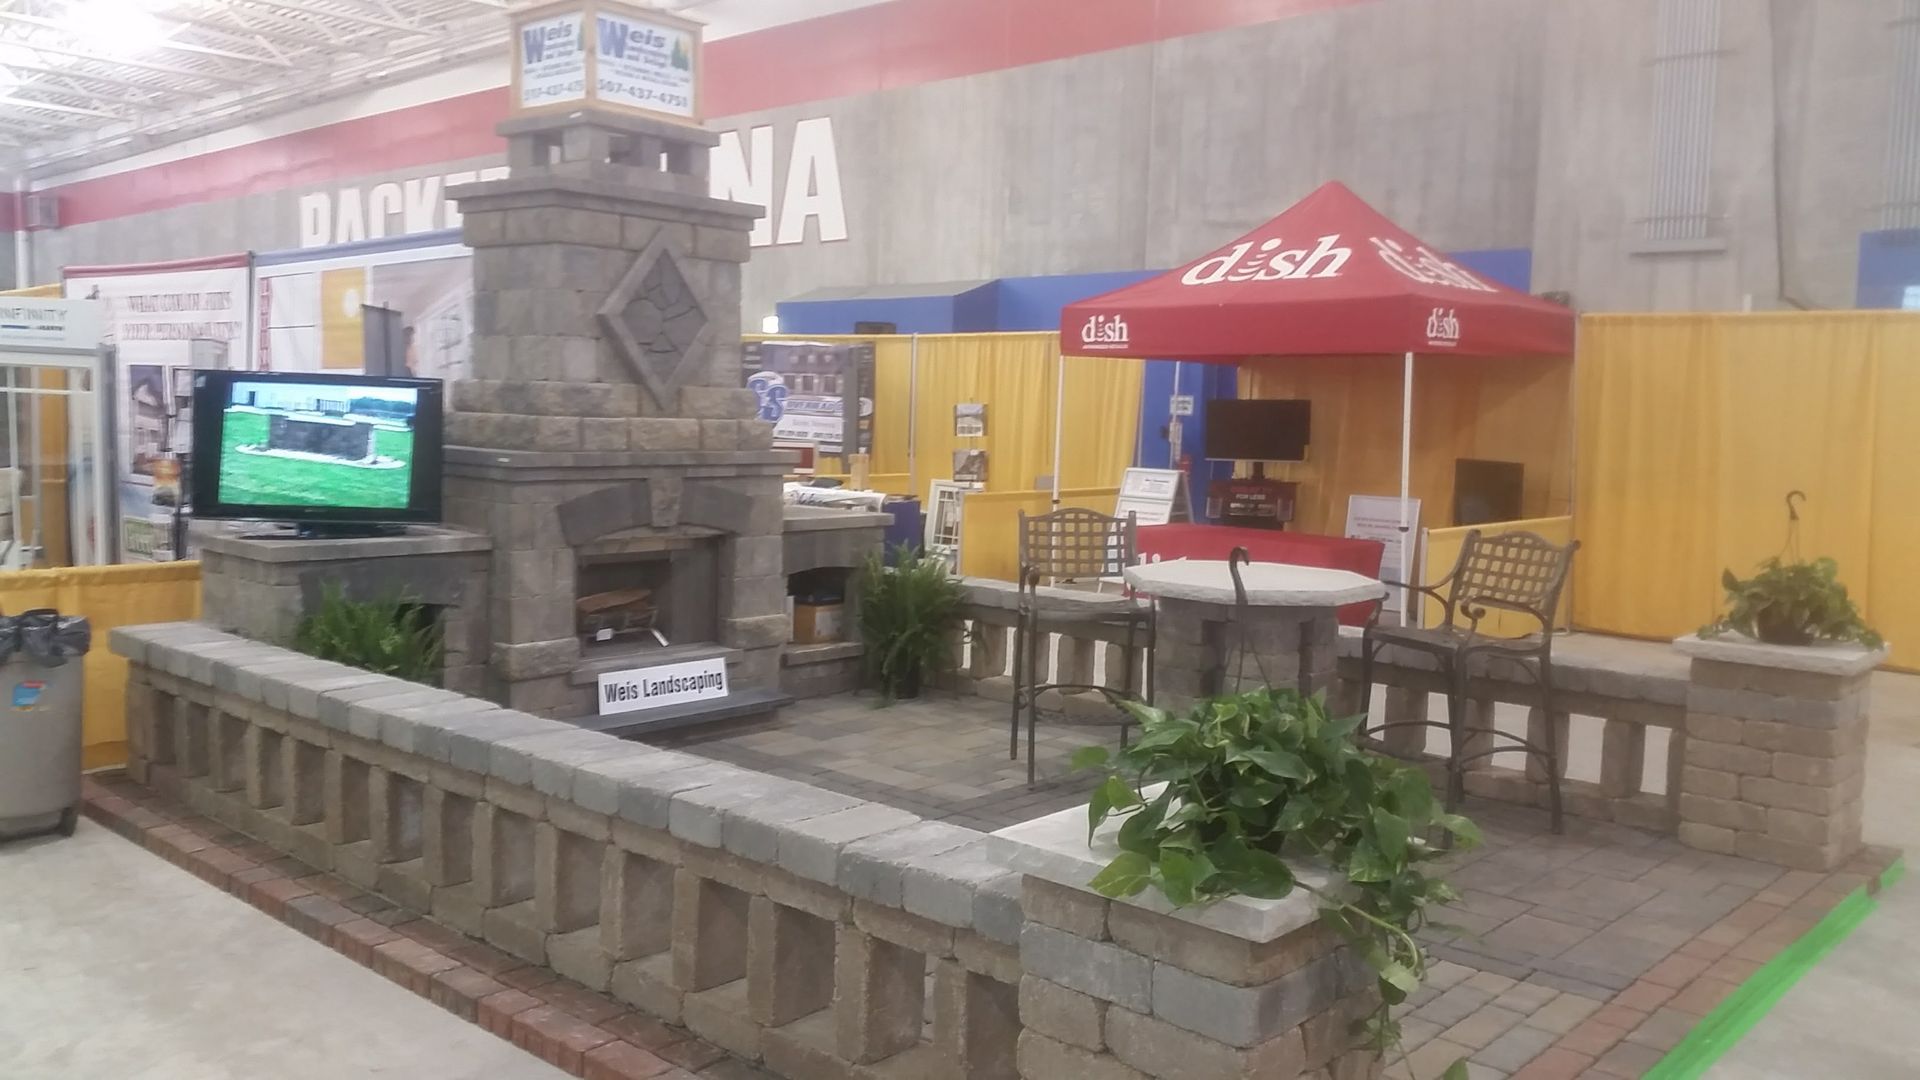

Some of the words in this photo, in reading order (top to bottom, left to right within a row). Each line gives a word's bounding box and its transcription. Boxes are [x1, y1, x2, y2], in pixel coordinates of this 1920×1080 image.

[524, 20, 573, 65] Weis
[597, 17, 667, 58] Weis
[1181, 234, 1352, 285] dish
[1369, 237, 1498, 292] dish
[1081, 314, 1129, 342] dish
[1427, 308, 1459, 339] dish
[604, 681, 639, 703] Weis
[642, 670, 724, 698] Landscaping
